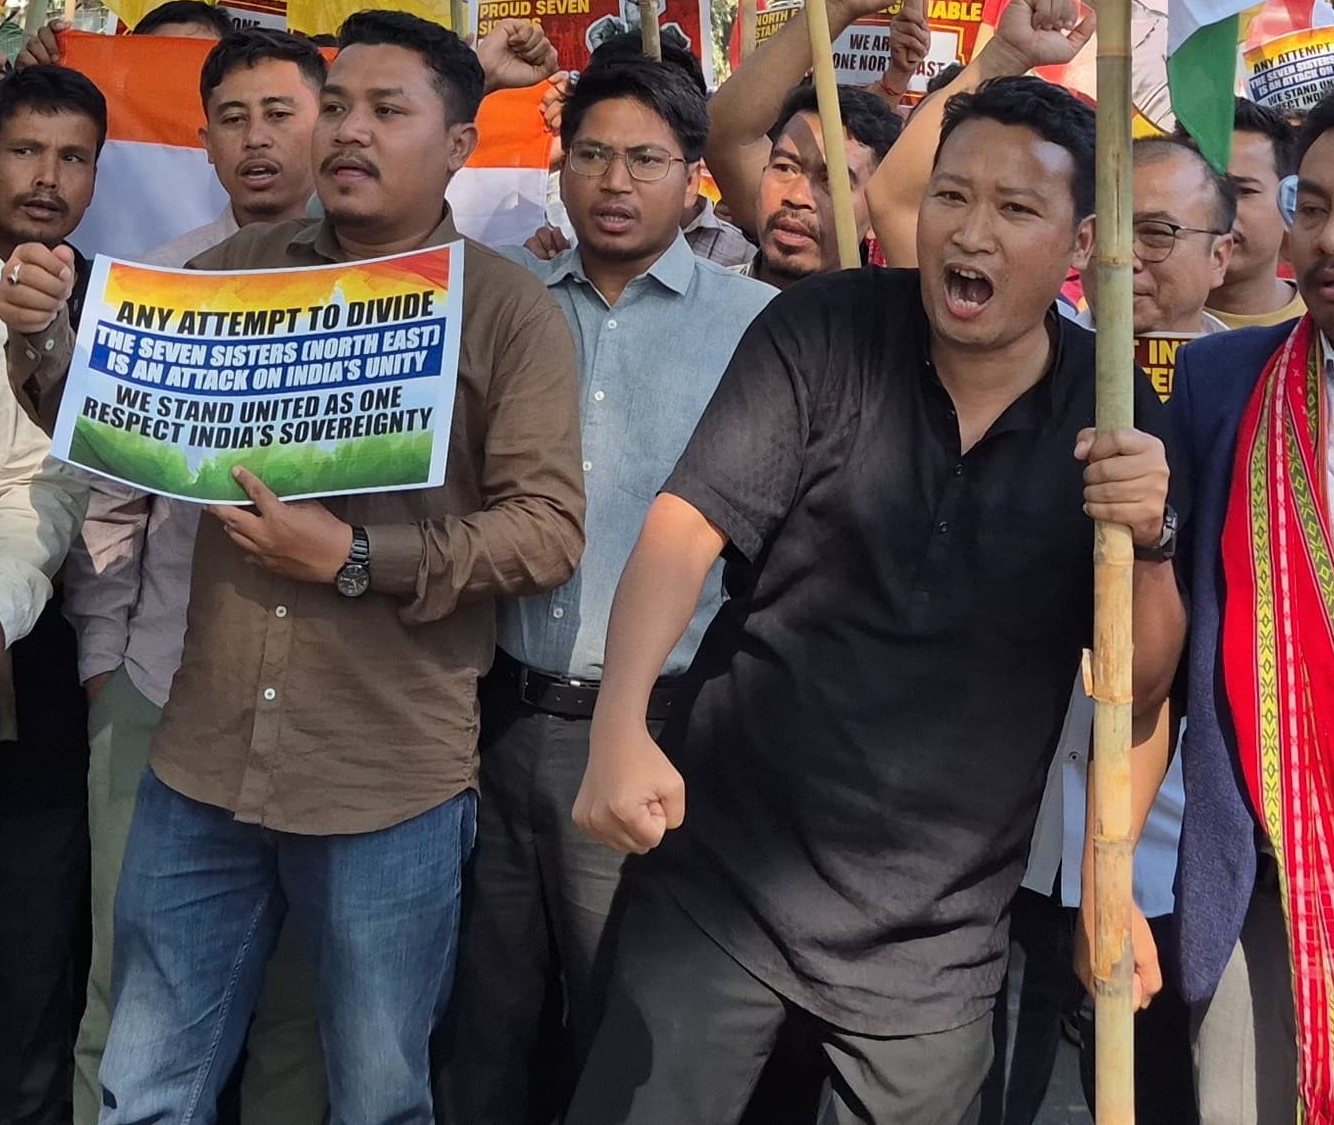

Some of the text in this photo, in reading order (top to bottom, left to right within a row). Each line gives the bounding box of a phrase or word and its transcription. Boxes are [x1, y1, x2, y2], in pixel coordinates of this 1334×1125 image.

[480, 0, 589, 18] PROUD SEVEN
[834, 53, 856, 70] ONE
[850, 35, 869, 50] WE
[1253, 45, 1331, 74] ANY ATTEMPT
[116, 290, 434, 337] ANY ATTEMPT TO DIVIDE
[97, 324, 440, 367] THE SEVEN SISTERS (NORTH EAST)
[106, 351, 428, 392] IS AN ATTACK ON INDIA'S UNITY
[82, 397, 434, 450] RESPECT INDIA'S SOVEREIGNTY
[115, 385, 403, 425] WE STAND UNITED AS ONE
